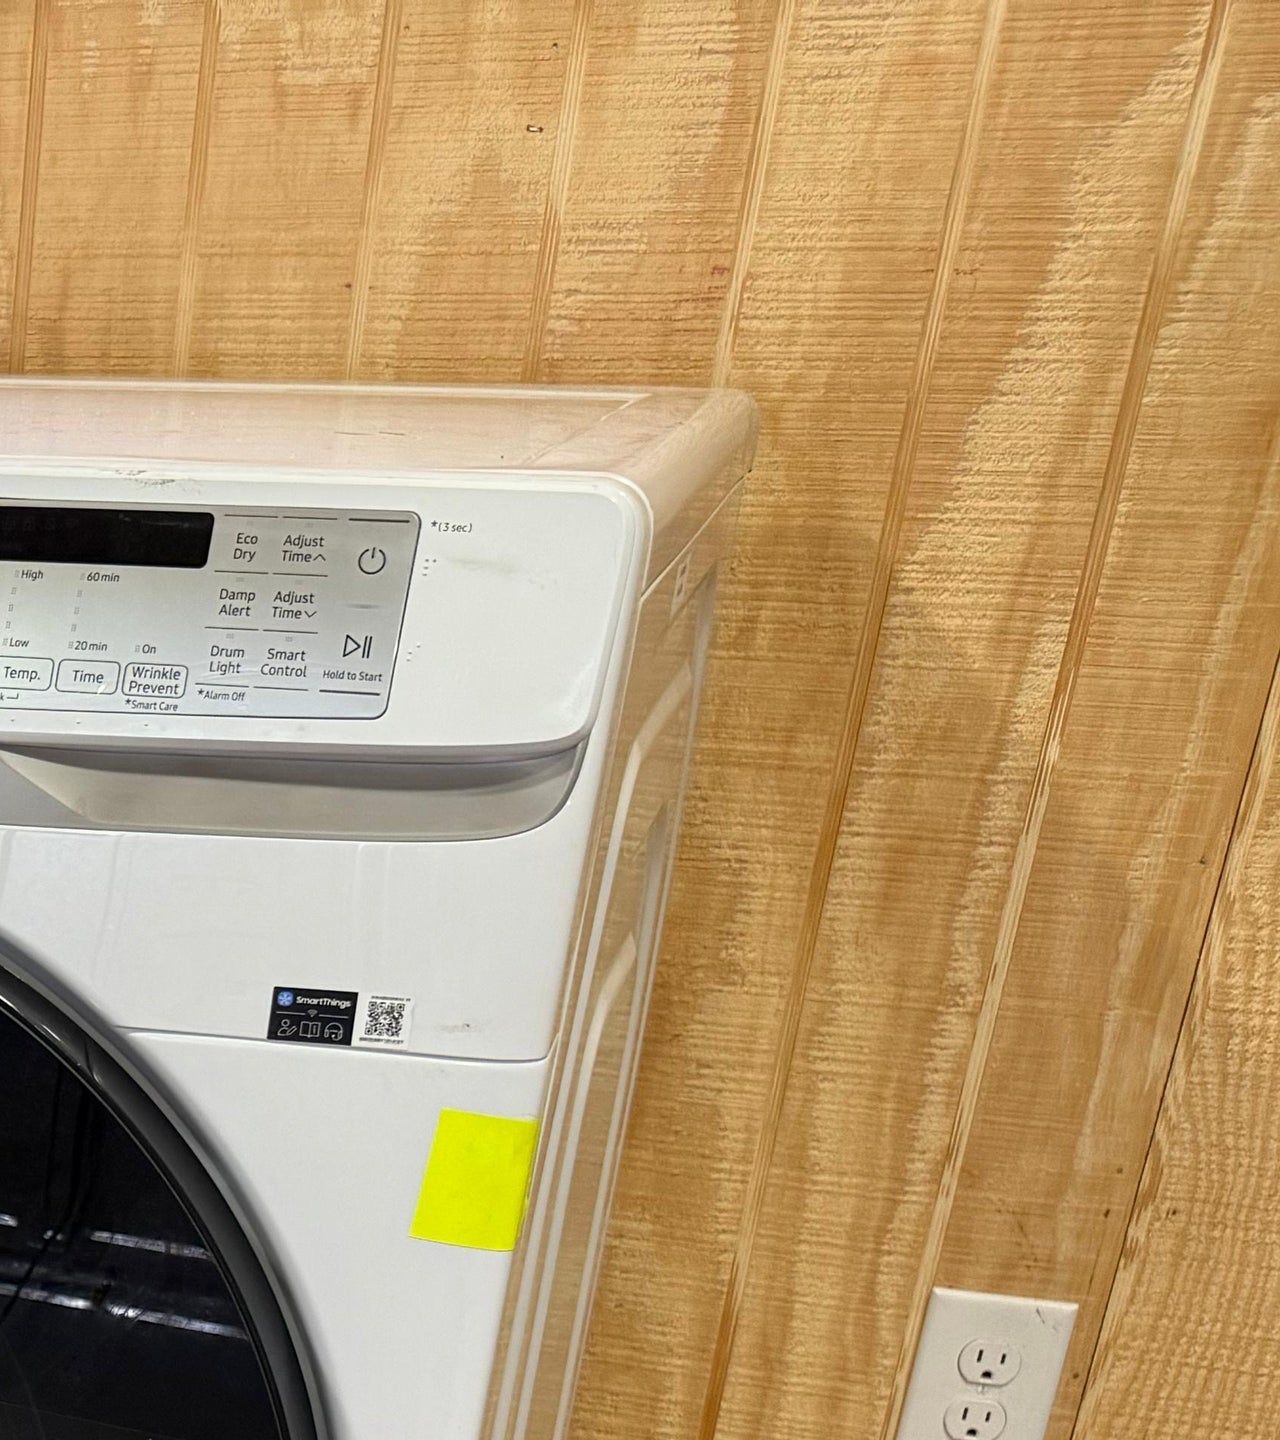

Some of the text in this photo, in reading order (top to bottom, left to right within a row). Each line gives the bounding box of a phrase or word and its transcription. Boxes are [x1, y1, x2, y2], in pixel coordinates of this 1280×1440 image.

[451, 522, 473, 533] sec)
[236, 532, 259, 545] Eco
[283, 535, 326, 549] Adjust
[233, 548, 257, 563] Dry
[281, 550, 312, 563] Time
[20, 569, 44, 581] High
[86, 572, 120, 583] 60 min
[219, 588, 256, 604] Damp
[273, 590, 315, 606] Adjust
[218, 604, 252, 617] Alert
[271, 606, 303, 620] Time
[9, 637, 30, 648] Low
[74, 640, 108, 652] 20 min
[142, 643, 157, 655] On
[210, 645, 245, 659] Drum
[267, 648, 306, 662] Smart
[4, 666, 41, 682] Temp.
[132, 666, 181, 681] Wrinkle
[209, 661, 242, 676] Light
[260, 663, 307, 678] Control
[72, 669, 105, 684] Time
[322, 670, 383, 683] Hold to Start
[128, 680, 180, 695] Prevent
[231, 691, 246, 702] Off
[159, 702, 179, 712] Care
[295, 995, 352, 1009] SmartThings
